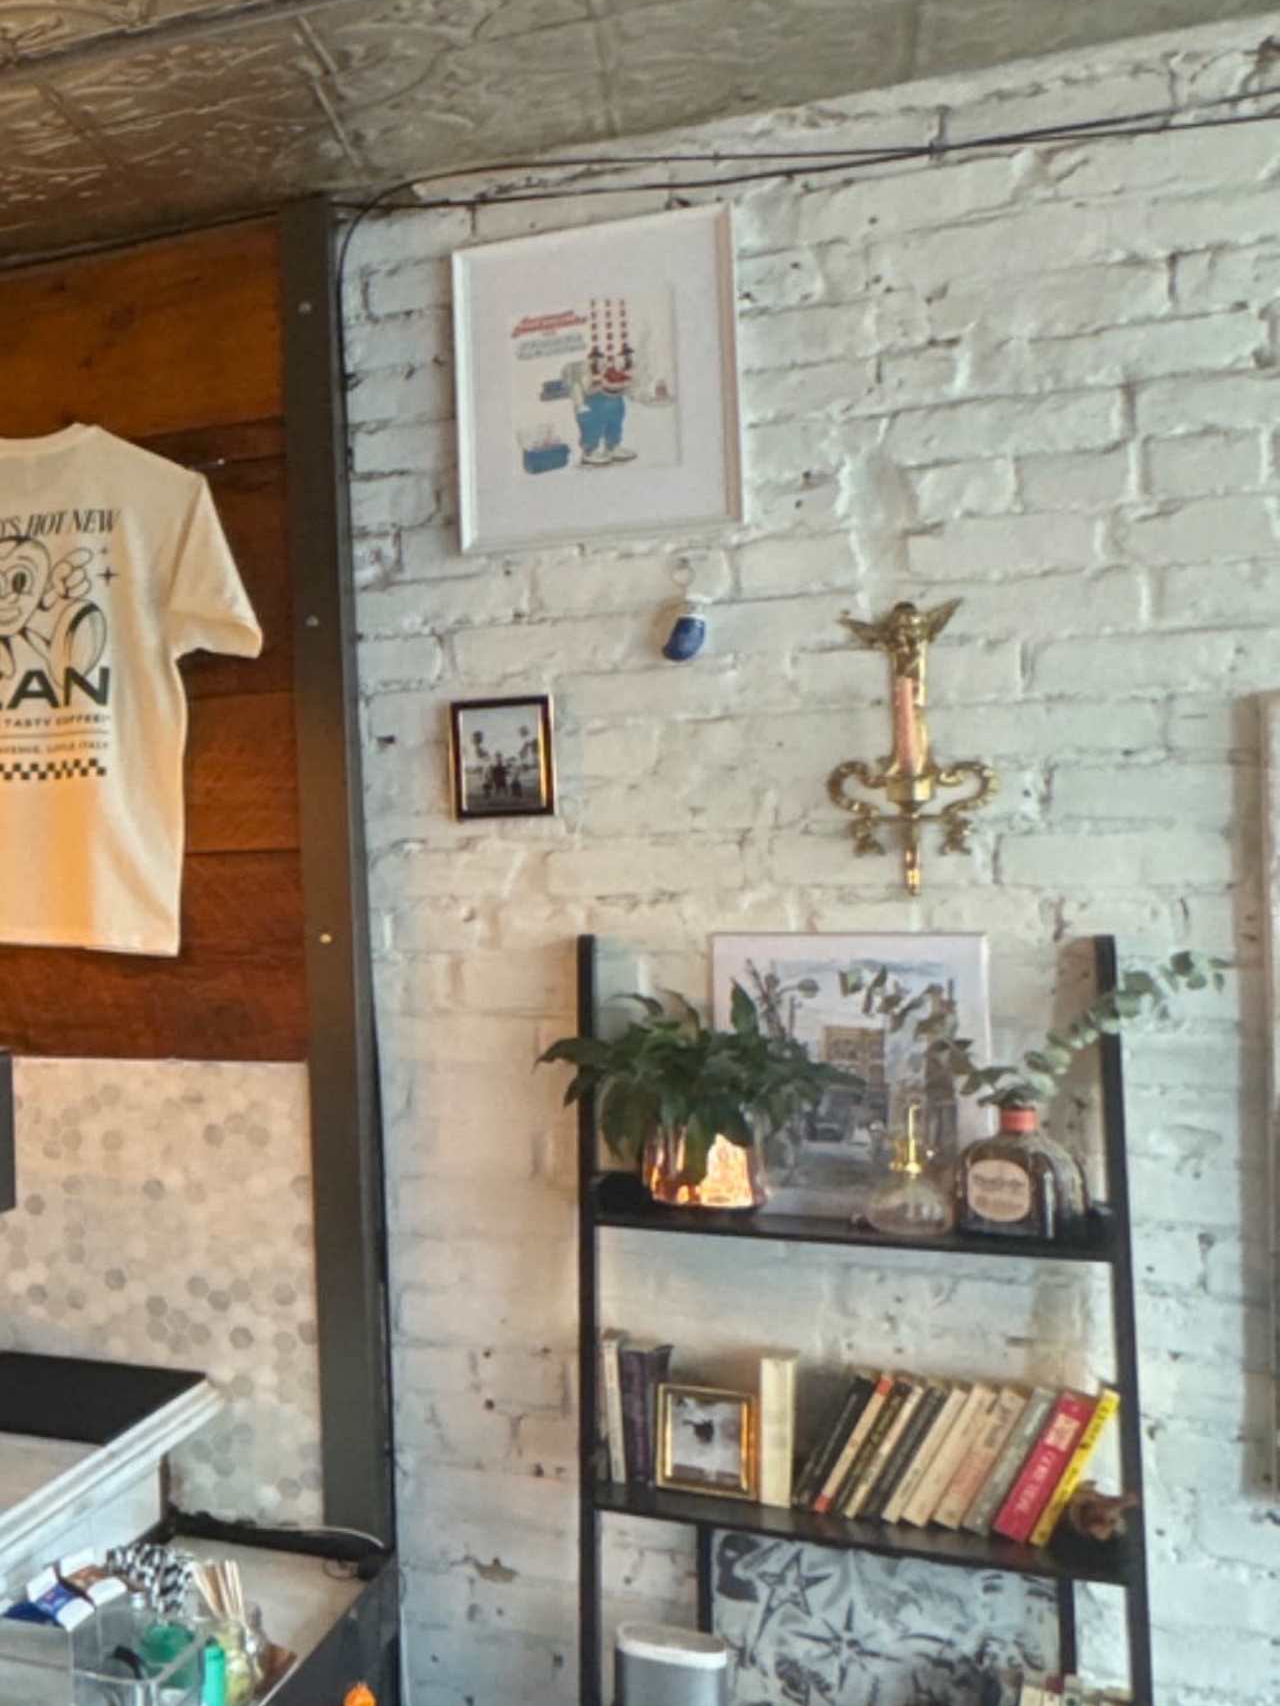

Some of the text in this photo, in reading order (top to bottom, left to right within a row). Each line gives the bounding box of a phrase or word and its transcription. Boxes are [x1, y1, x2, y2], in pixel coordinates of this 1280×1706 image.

[27, 509, 69, 537] HOT
[71, 507, 121, 535] NEW
[4, 718, 51, 728] TASTY
